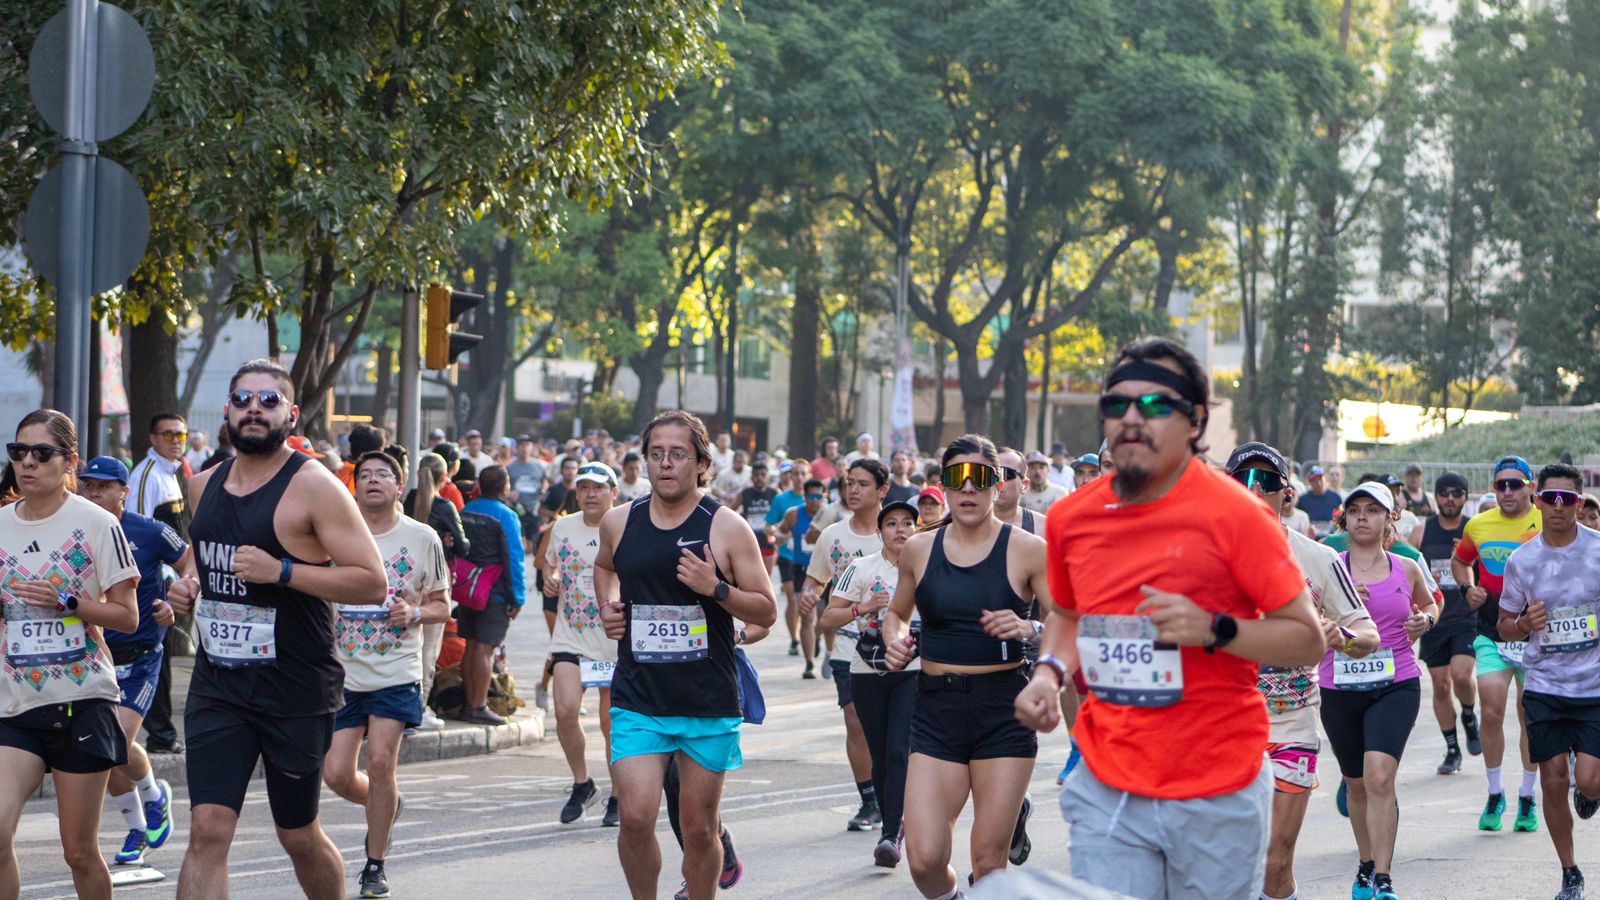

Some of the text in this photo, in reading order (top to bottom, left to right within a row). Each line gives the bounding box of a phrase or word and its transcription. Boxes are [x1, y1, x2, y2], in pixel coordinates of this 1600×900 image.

[199, 539, 236, 572] MN
[21, 621, 65, 638] 6770
[210, 621, 253, 642] 8377
[647, 622, 690, 637] 2619
[1546, 617, 1588, 634] 17016
[1098, 642, 1153, 664] 3466
[1503, 641, 1524, 652] 104
[1343, 660, 1385, 674] 16219
